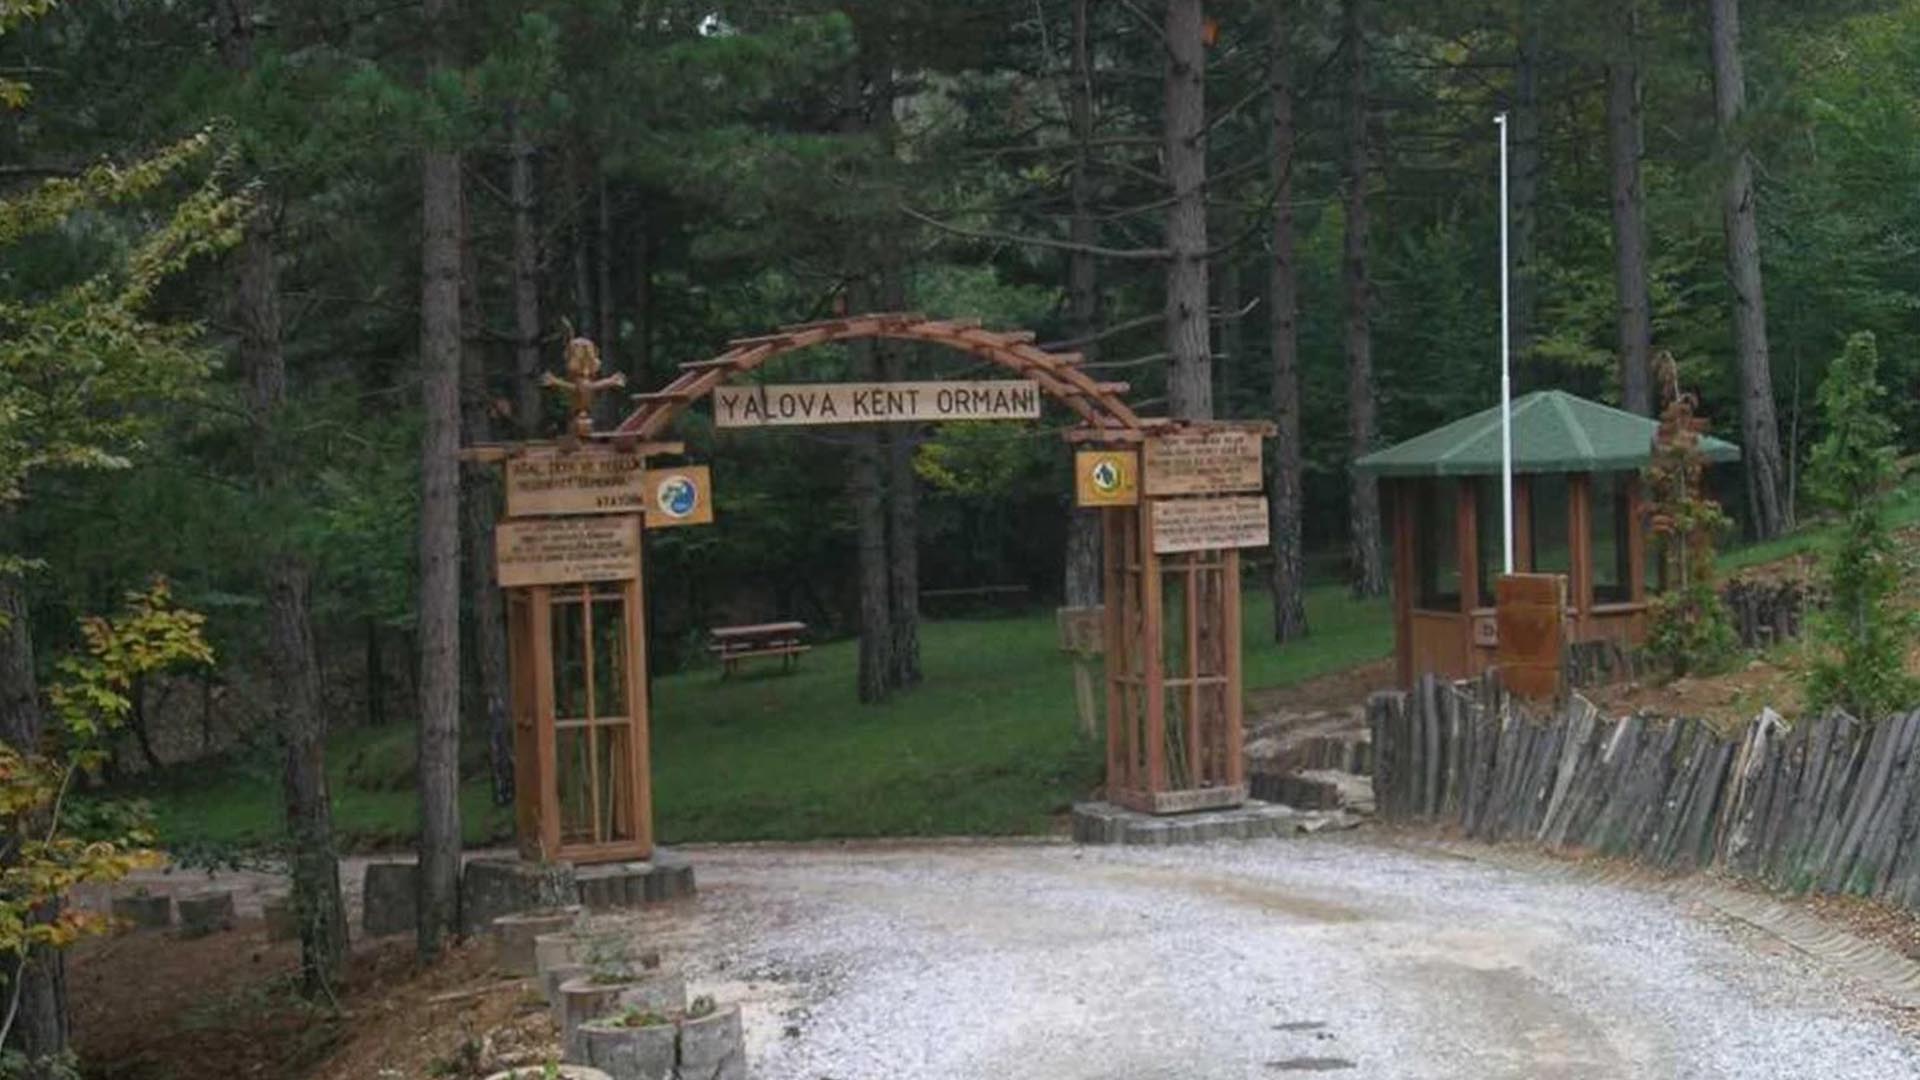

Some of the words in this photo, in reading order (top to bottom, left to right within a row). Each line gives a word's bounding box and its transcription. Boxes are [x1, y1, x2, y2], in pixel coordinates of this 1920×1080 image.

[721, 391, 837, 419] YALOVA
[853, 389, 920, 415] KENT
[937, 388, 1035, 414] ORMANI
